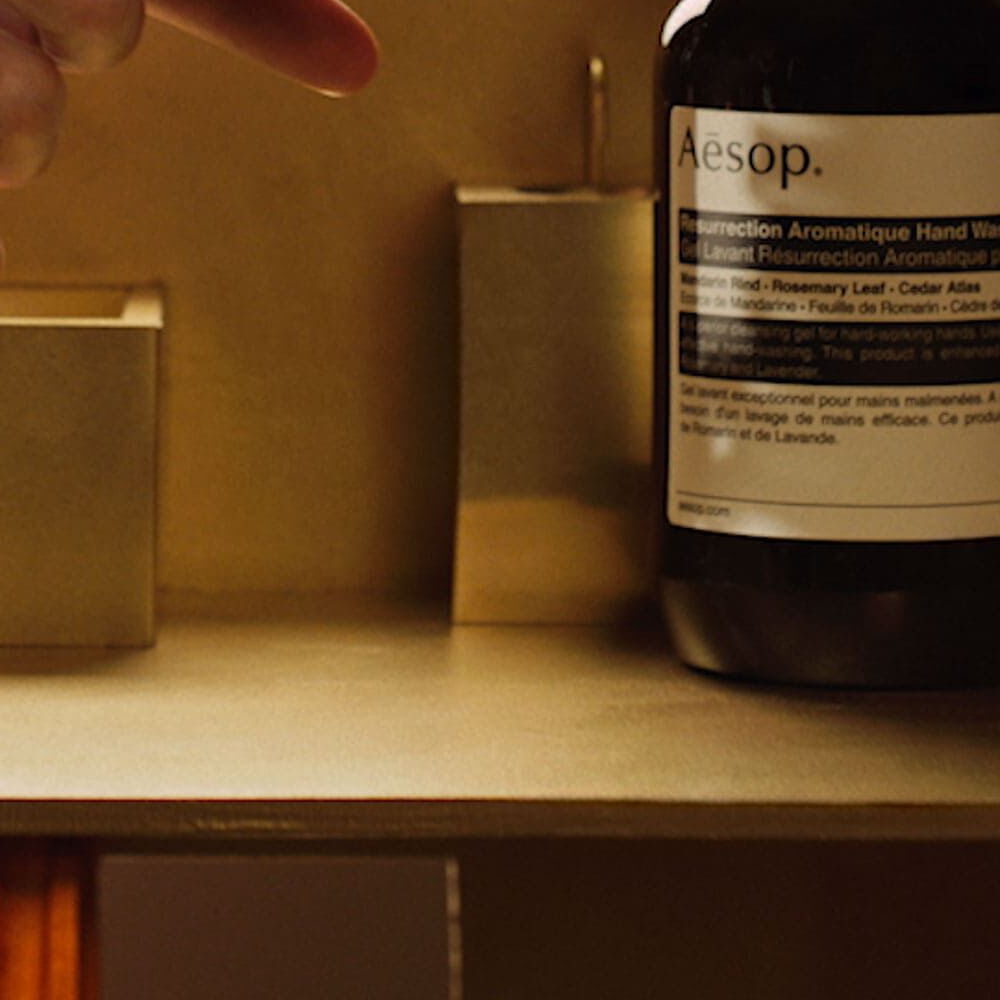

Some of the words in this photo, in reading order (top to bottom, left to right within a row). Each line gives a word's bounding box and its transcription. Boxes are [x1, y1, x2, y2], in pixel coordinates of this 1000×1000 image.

[677, 125, 824, 189] Aēsop.
[788, 219, 911, 245] Aromatique
[916, 222, 969, 241] Hand
[704, 240, 755, 264] Lavant
[884, 247, 985, 268] Aromatique
[731, 276, 760, 291] Rind
[772, 279, 849, 298] Rosemary
[853, 281, 885, 294] Leaf
[898, 281, 942, 295] Cedar
[946, 280, 981, 294] Atlas
[859, 301, 877, 314] de
[818, 395, 851, 409] pour
[856, 394, 900, 408] mains
[745, 408, 788, 426] lavage
[795, 412, 813, 425] de
[821, 413, 865, 427] mains
[938, 411, 959, 425] Ce
[754, 429, 771, 442] de
[775, 430, 839, 446] Lavande.
